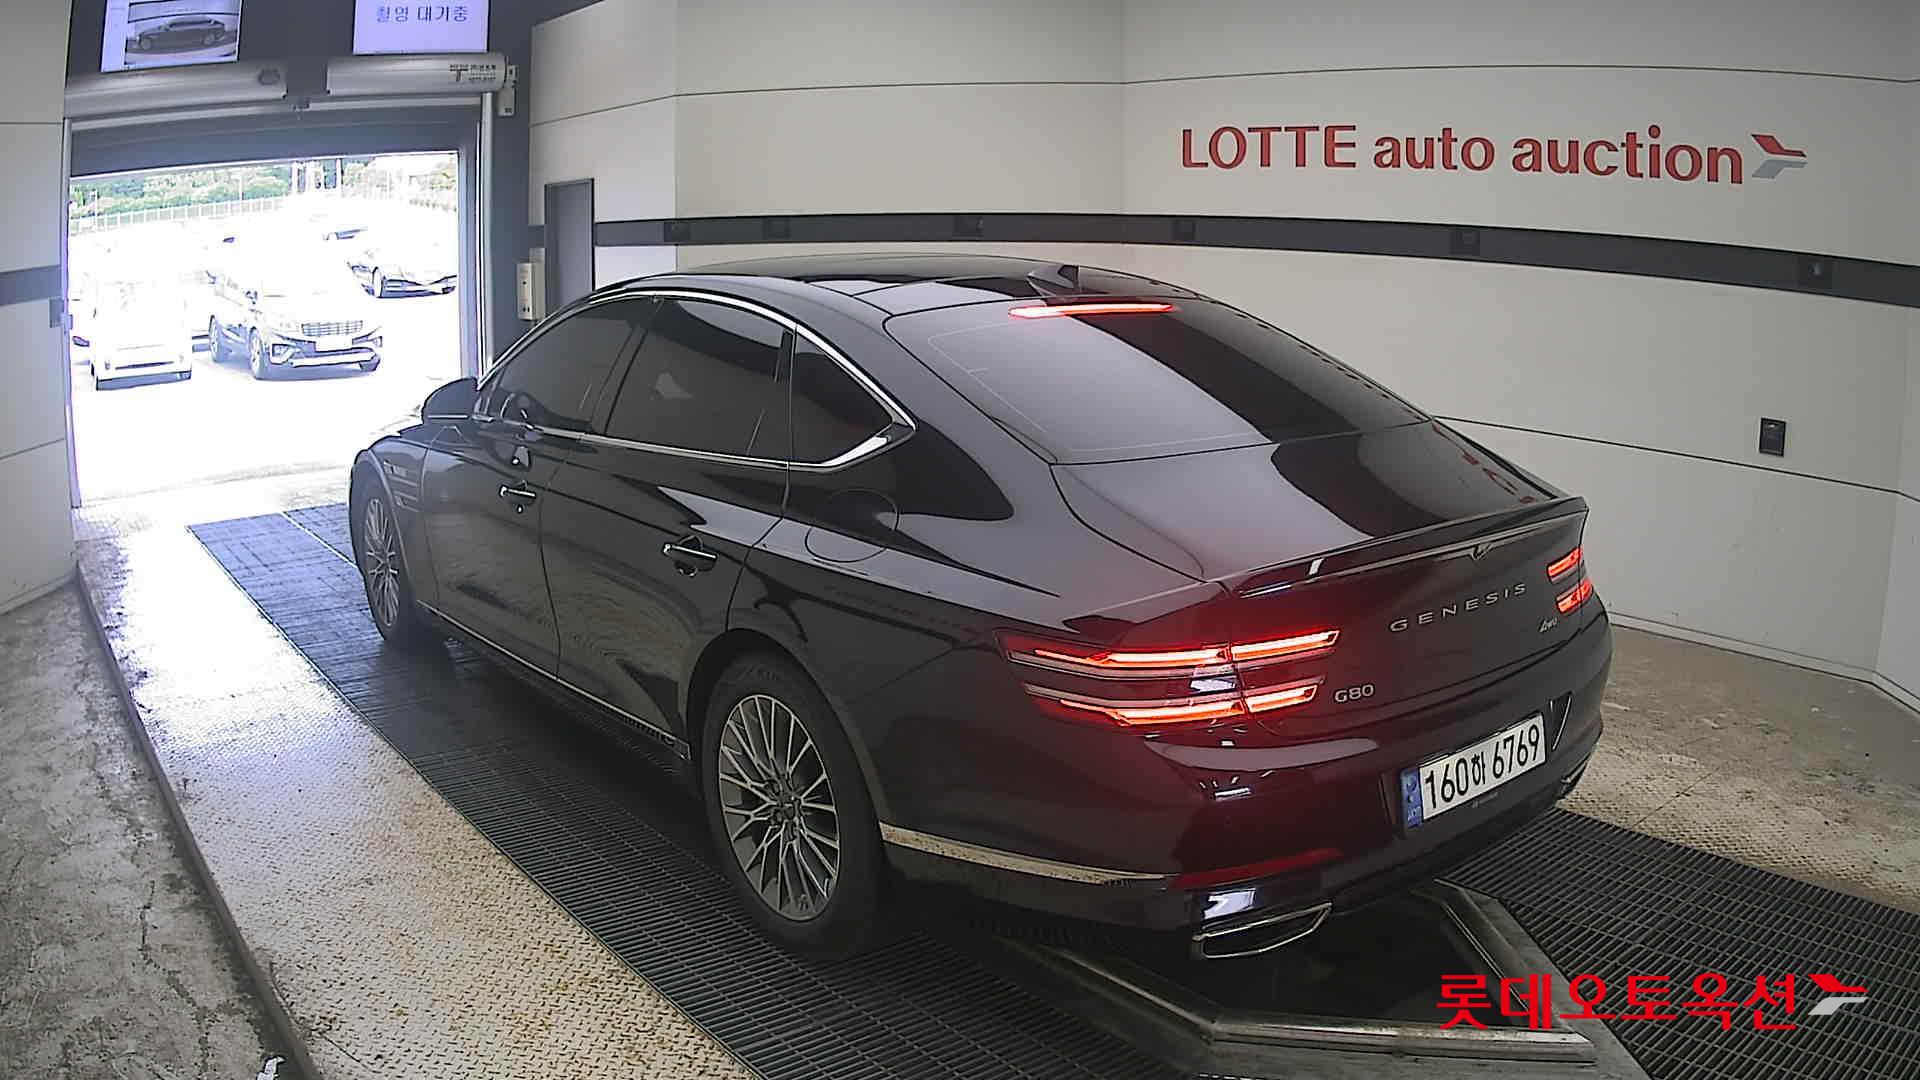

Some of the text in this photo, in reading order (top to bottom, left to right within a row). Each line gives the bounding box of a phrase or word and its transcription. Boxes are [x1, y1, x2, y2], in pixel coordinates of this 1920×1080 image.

[417, 5, 469, 23] 대기중
[1182, 125, 1743, 184] LOTTE auto auction
[1389, 583, 1526, 632] GENESIS
[1335, 684, 1375, 703] G80
[1424, 751, 1486, 809] 160하
[1492, 724, 1540, 779] 6769
